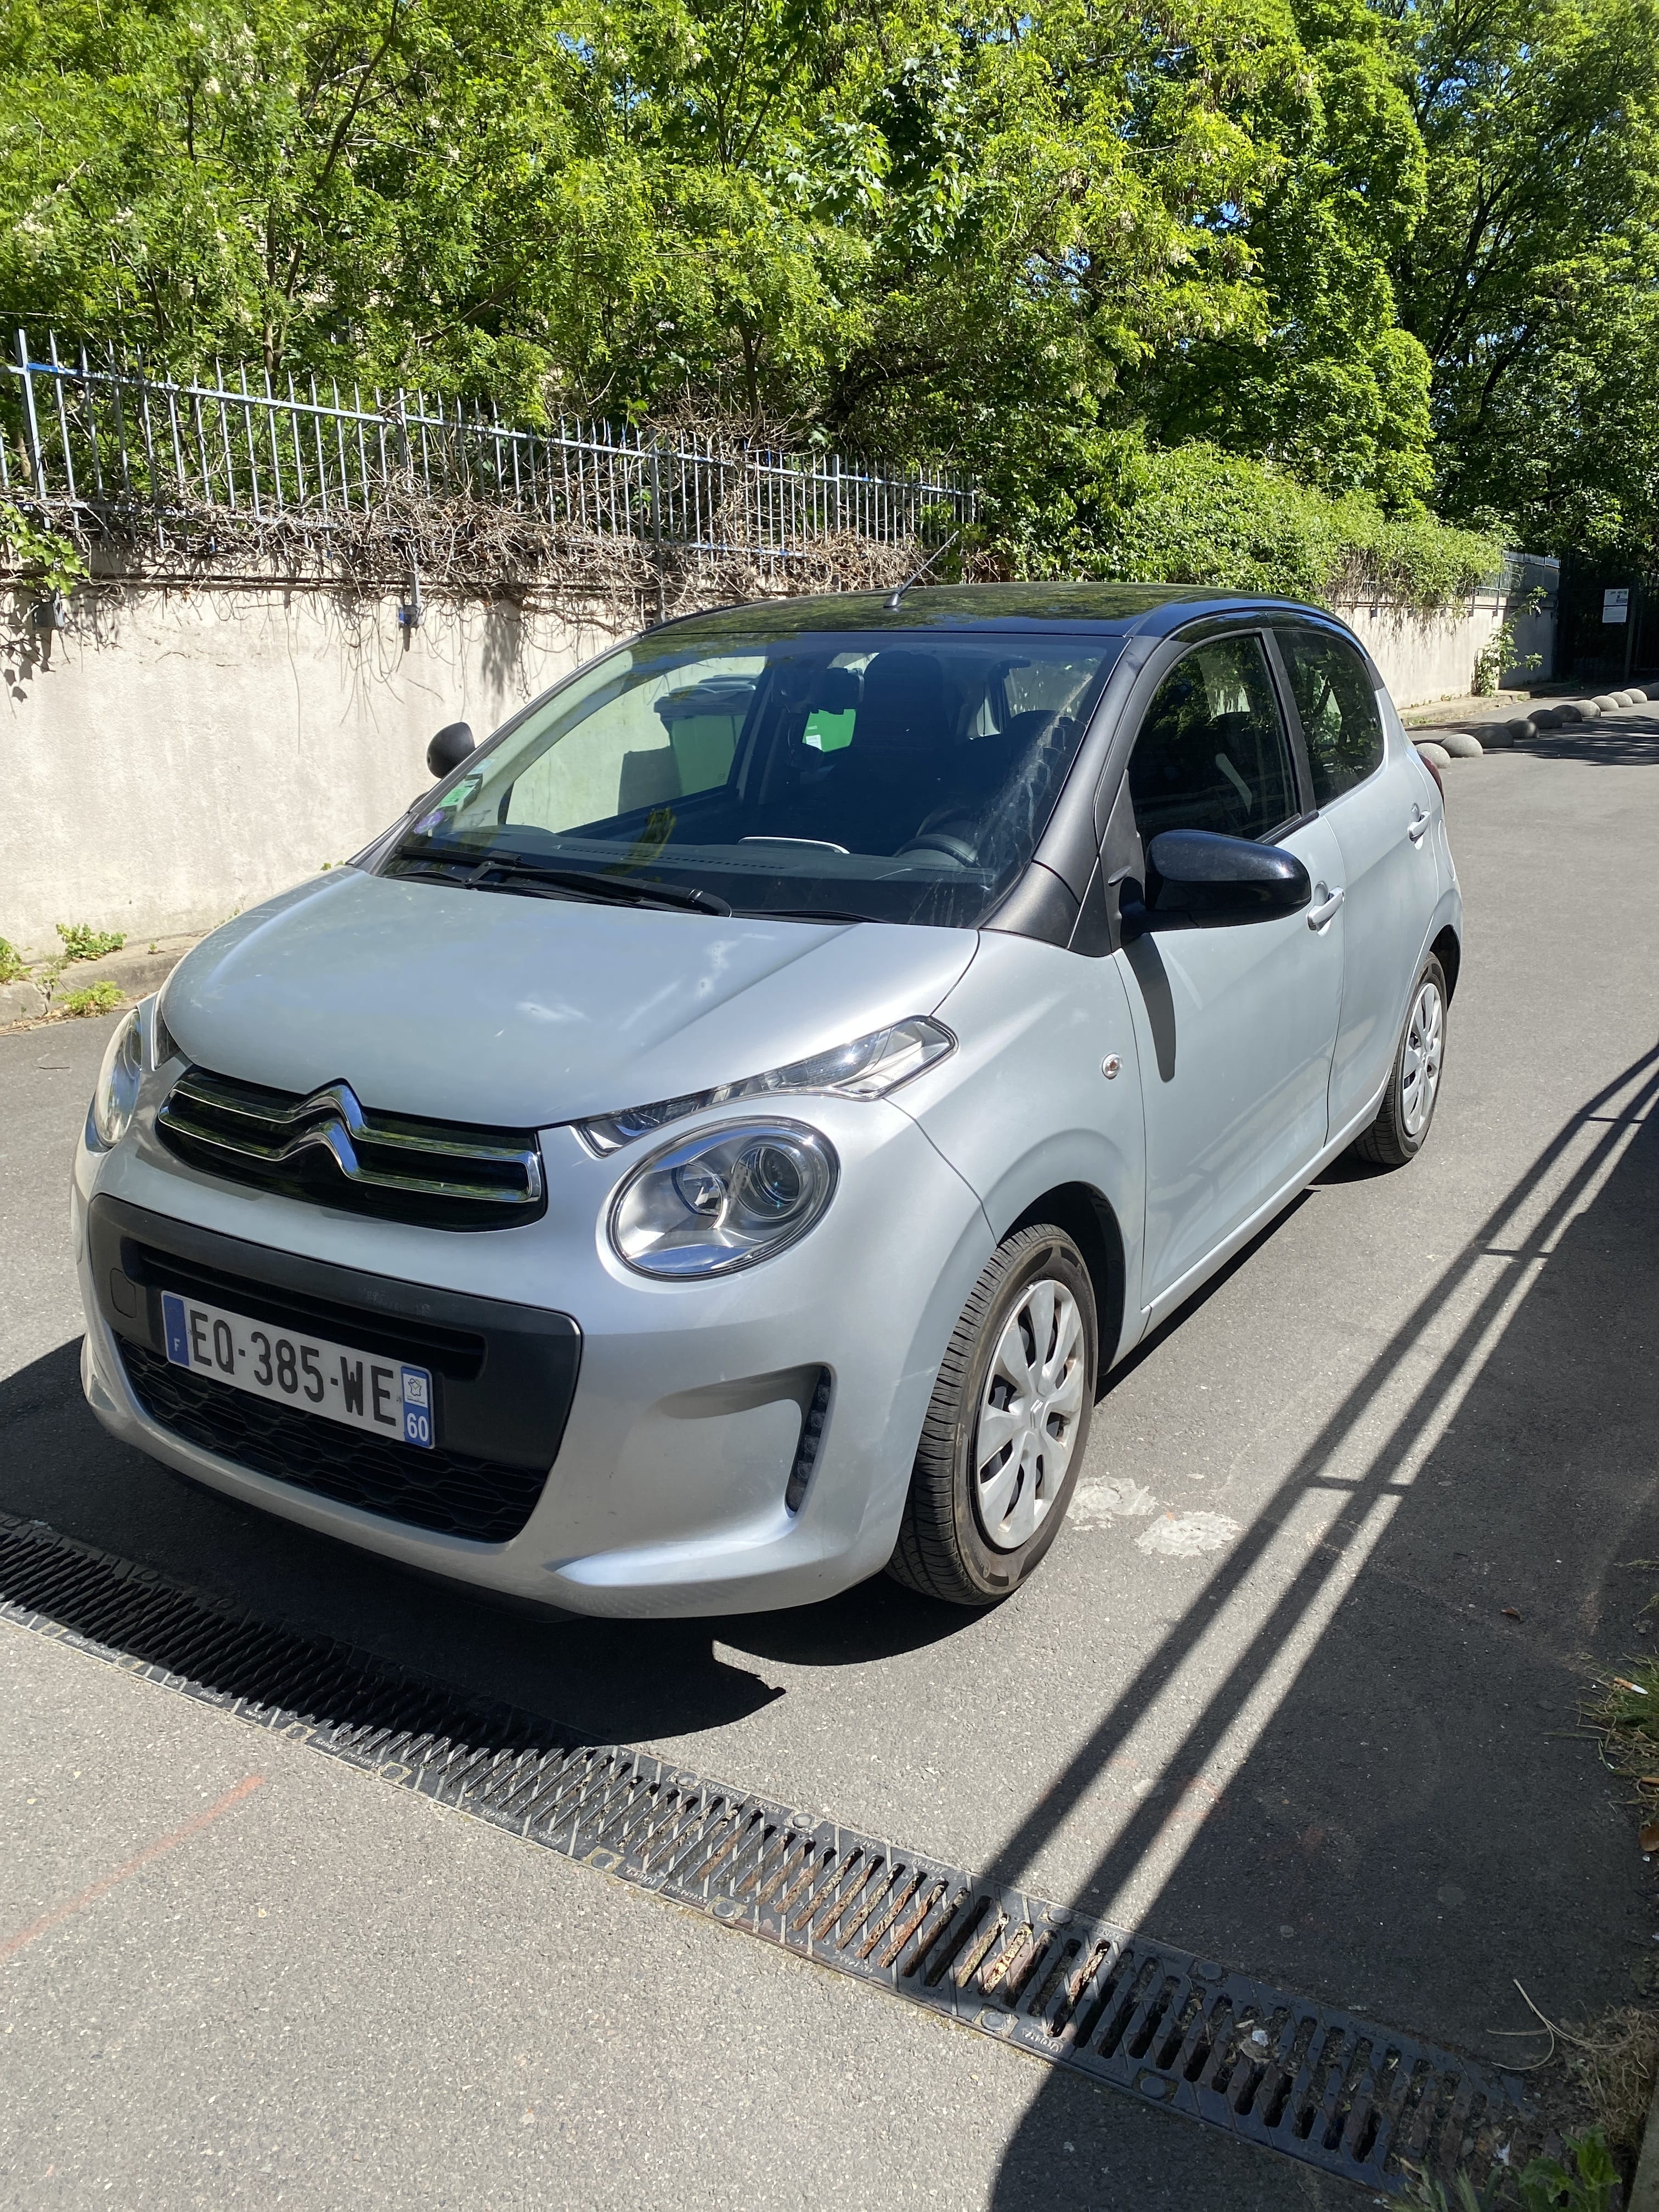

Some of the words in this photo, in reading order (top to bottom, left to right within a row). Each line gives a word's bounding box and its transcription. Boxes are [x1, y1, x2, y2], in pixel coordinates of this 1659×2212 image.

[174, 1337, 180, 1352] F
[190, 1309, 396, 1427] EQ-385-WE
[407, 1412, 429, 1442] 60
